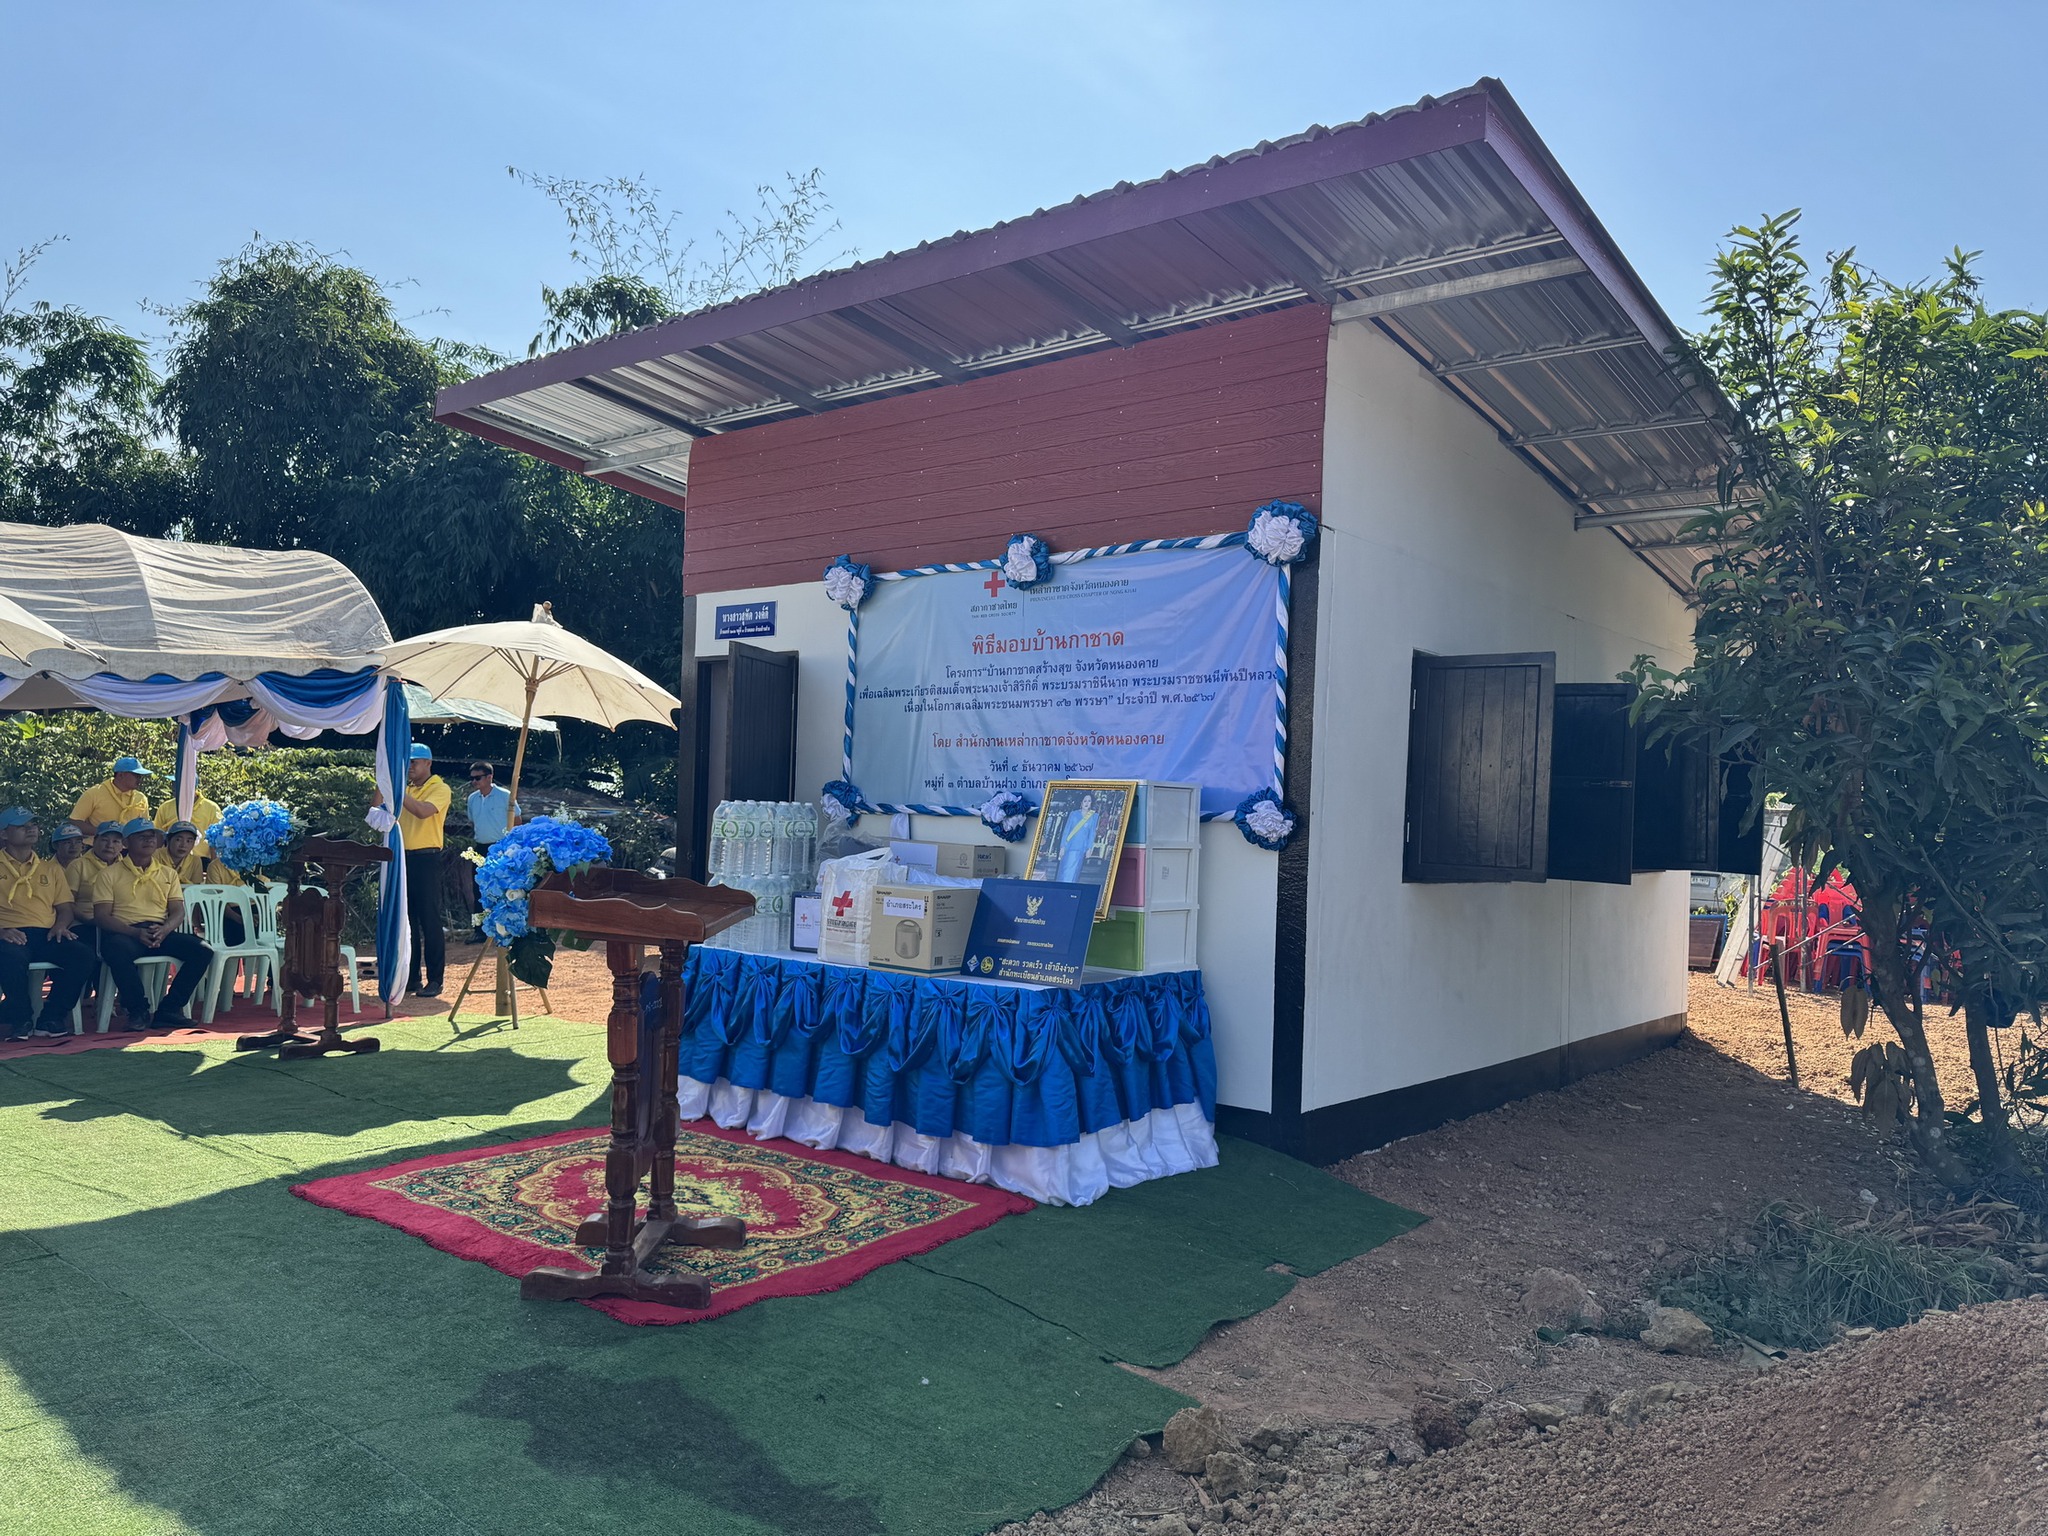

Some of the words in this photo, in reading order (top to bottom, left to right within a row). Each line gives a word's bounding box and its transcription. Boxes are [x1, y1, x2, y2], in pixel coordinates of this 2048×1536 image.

[1030, 579, 1129, 595] เหล่ากาชาดจังหวัดหนองคาย
[1030, 594, 1056, 602] PROVINCIAL
[1081, 590, 1102, 598] CHAPTER
[970, 600, 1018, 612] สภากาชาดไทย
[972, 628, 1124, 655] พิธีมอบบ้านกาชาด
[1075, 657, 1159, 672] จังหวัดหนองคาย
[859, 675, 1040, 700] เพื่อเฉลิมพระเกียรติสมเด็จพระนางเจ้าสิริกิติ์
[1042, 675, 1128, 691] พระบรมราชินีนาถ
[904, 698, 1053, 713] เนื่องในโอกาสเฉลิมพระชนมพรรษา
[1117, 691, 1157, 705] ประจำปี
[1161, 692, 1216, 704] พ.ศ.๒๕๖๗
[932, 732, 952, 748] โดย
[956, 731, 1165, 748] สำนักงานเหล่ากาชาดจังหวัดหนองคาย
[990, 757, 1009, 772] วันที่
[1021, 759, 1061, 772] ธันวาคม
[1064, 762, 1094, 772] ๒๕๖๗
[924, 773, 944, 791] หมู่ที่
[956, 776, 1018, 789] ตำบลบ้านฝาง
[886, 900, 922, 910] อำเภอสระใคร
[1022, 959, 1043, 970] รวดเร็ว
[998, 967, 1074, 985] สำนักทะเบียนอำเภอสระใคร
